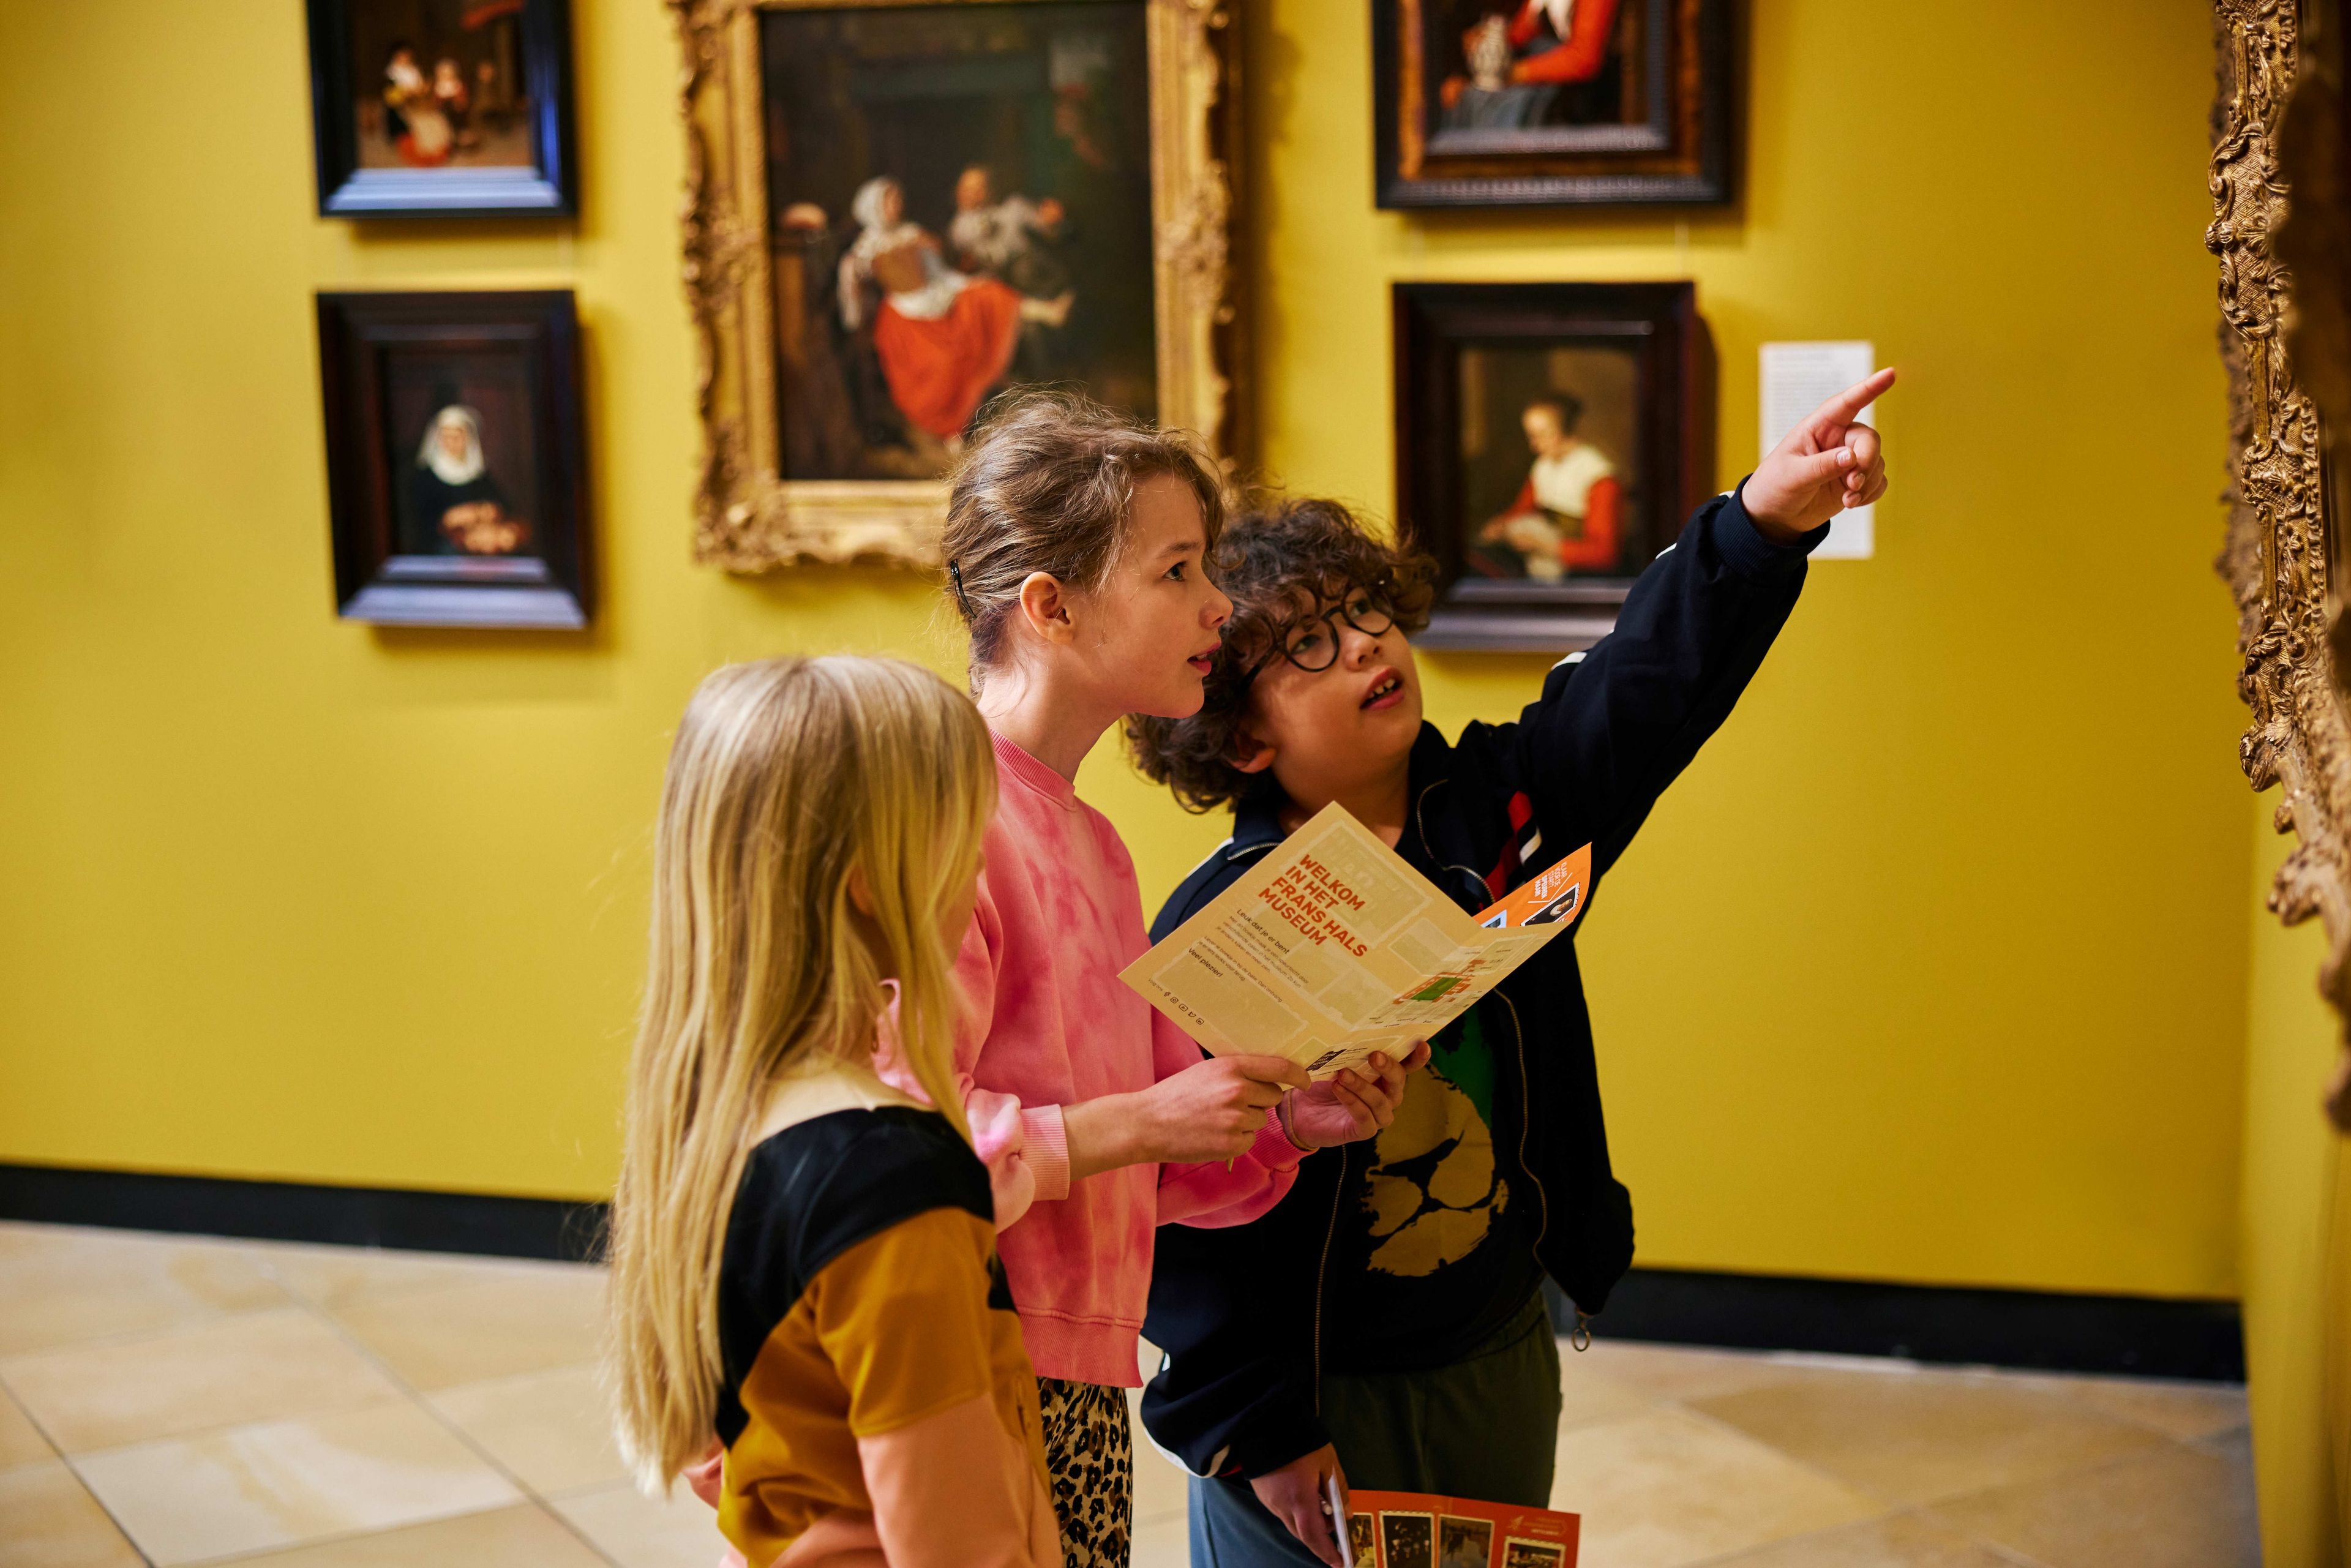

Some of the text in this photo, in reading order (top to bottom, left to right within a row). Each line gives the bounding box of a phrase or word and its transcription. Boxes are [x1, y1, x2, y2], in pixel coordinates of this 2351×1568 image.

[1286, 866, 1338, 909] IN HET
[1300, 855, 1365, 910] WELKOM
[1236, 909, 1252, 923] Leuk
[1251, 921, 1262, 931] dat
[1274, 940, 1289, 954] bent
[1258, 888, 1327, 945] MUSEUM
[1272, 876, 1367, 956] FRANS HALS
[1189, 948, 1223, 977] Veel plezier!
[1257, 980, 1267, 989] Dan
[1299, 975, 1308, 983] door
